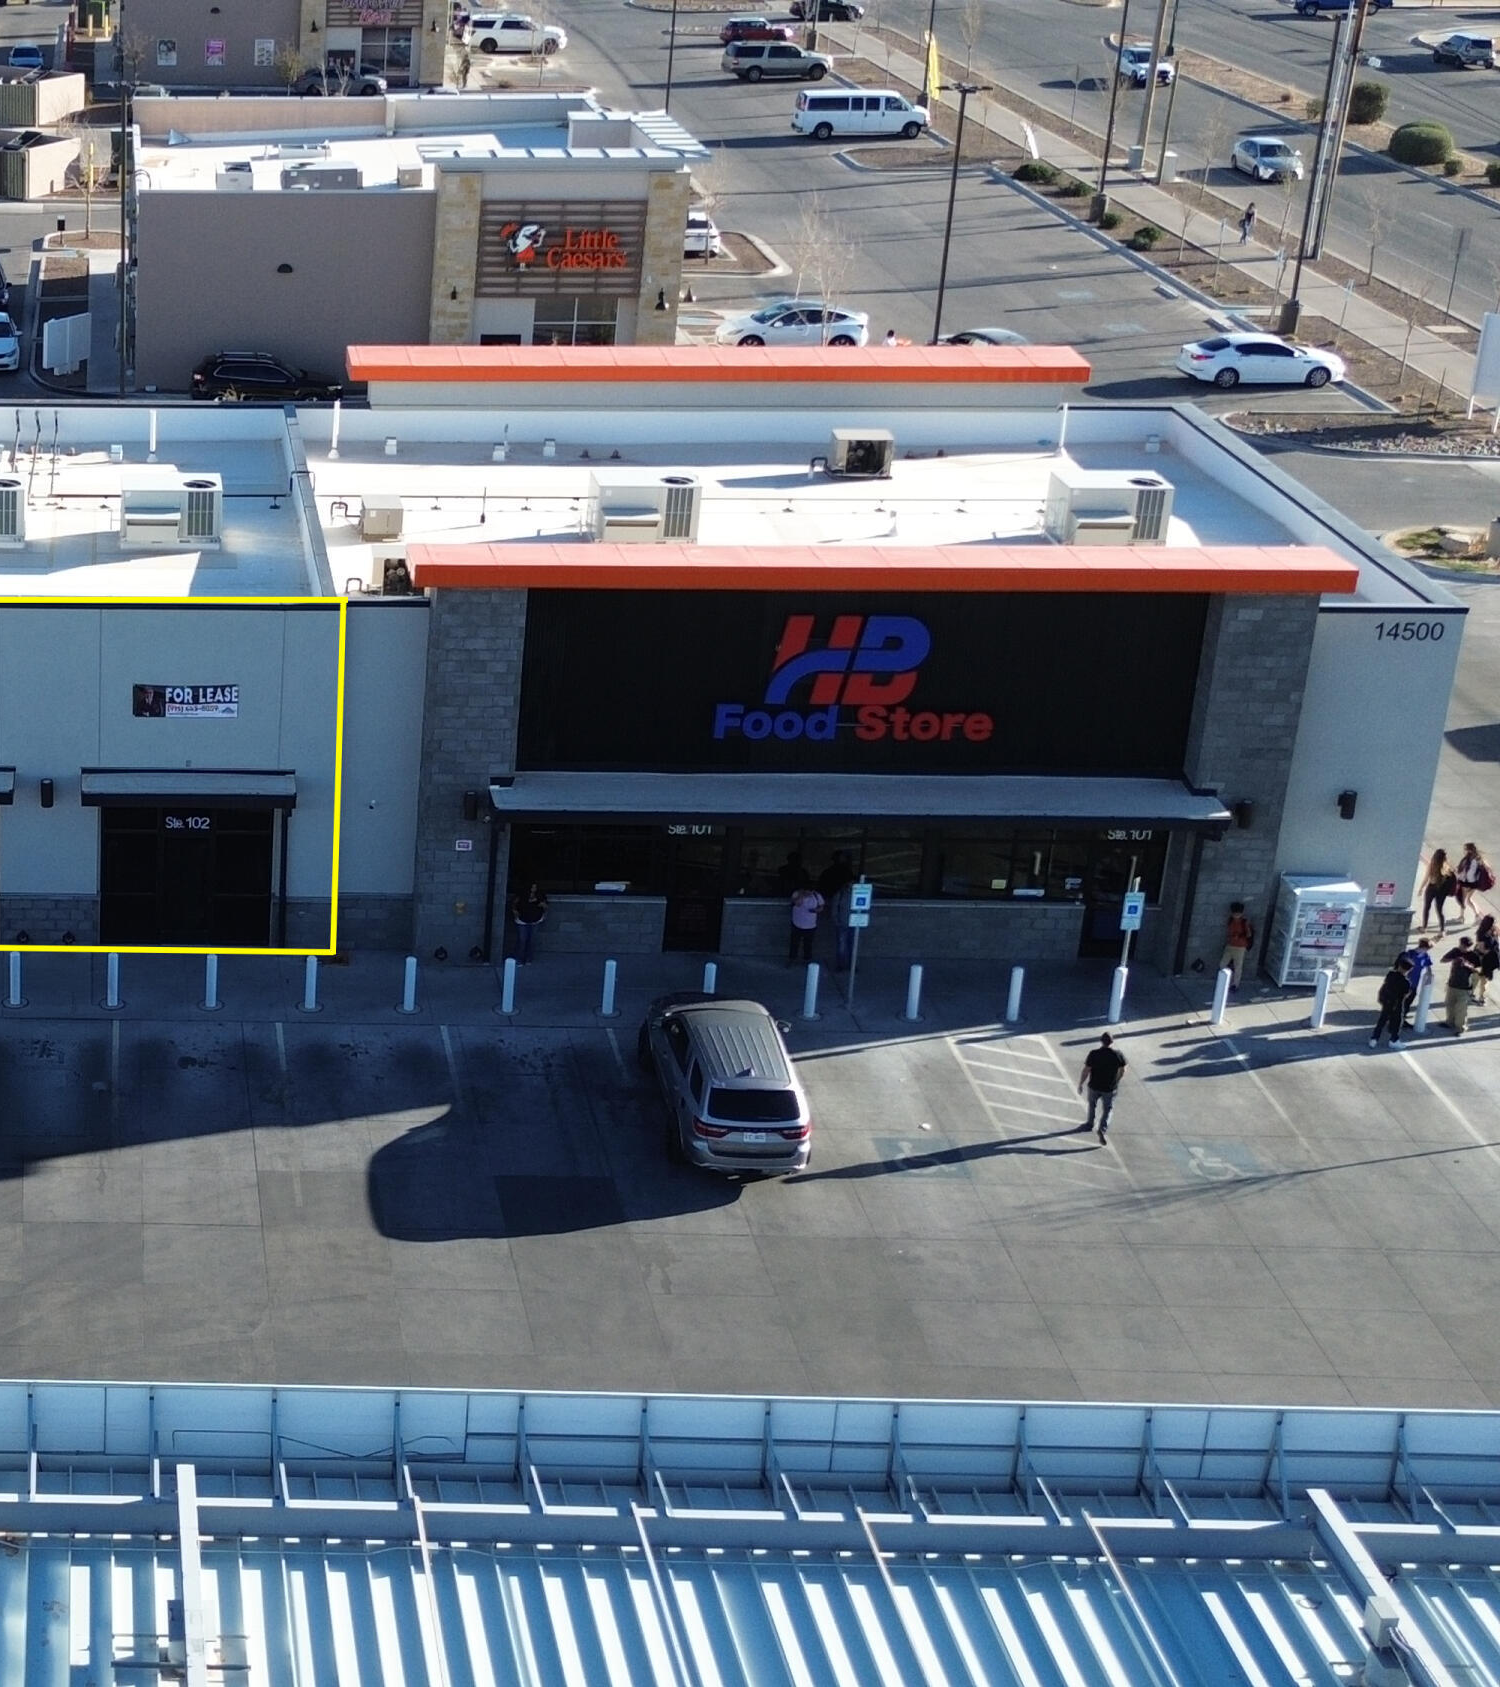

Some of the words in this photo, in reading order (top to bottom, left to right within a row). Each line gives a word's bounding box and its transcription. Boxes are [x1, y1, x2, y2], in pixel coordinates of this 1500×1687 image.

[564, 227, 619, 250] Little
[547, 246, 626, 269] Caesars
[1374, 622, 1445, 641] 14500
[165, 687, 193, 704] FOR
[199, 686, 239, 704] LEASE
[713, 703, 839, 740] Food
[854, 704, 994, 742] Store
[186, 816, 210, 829] 102
